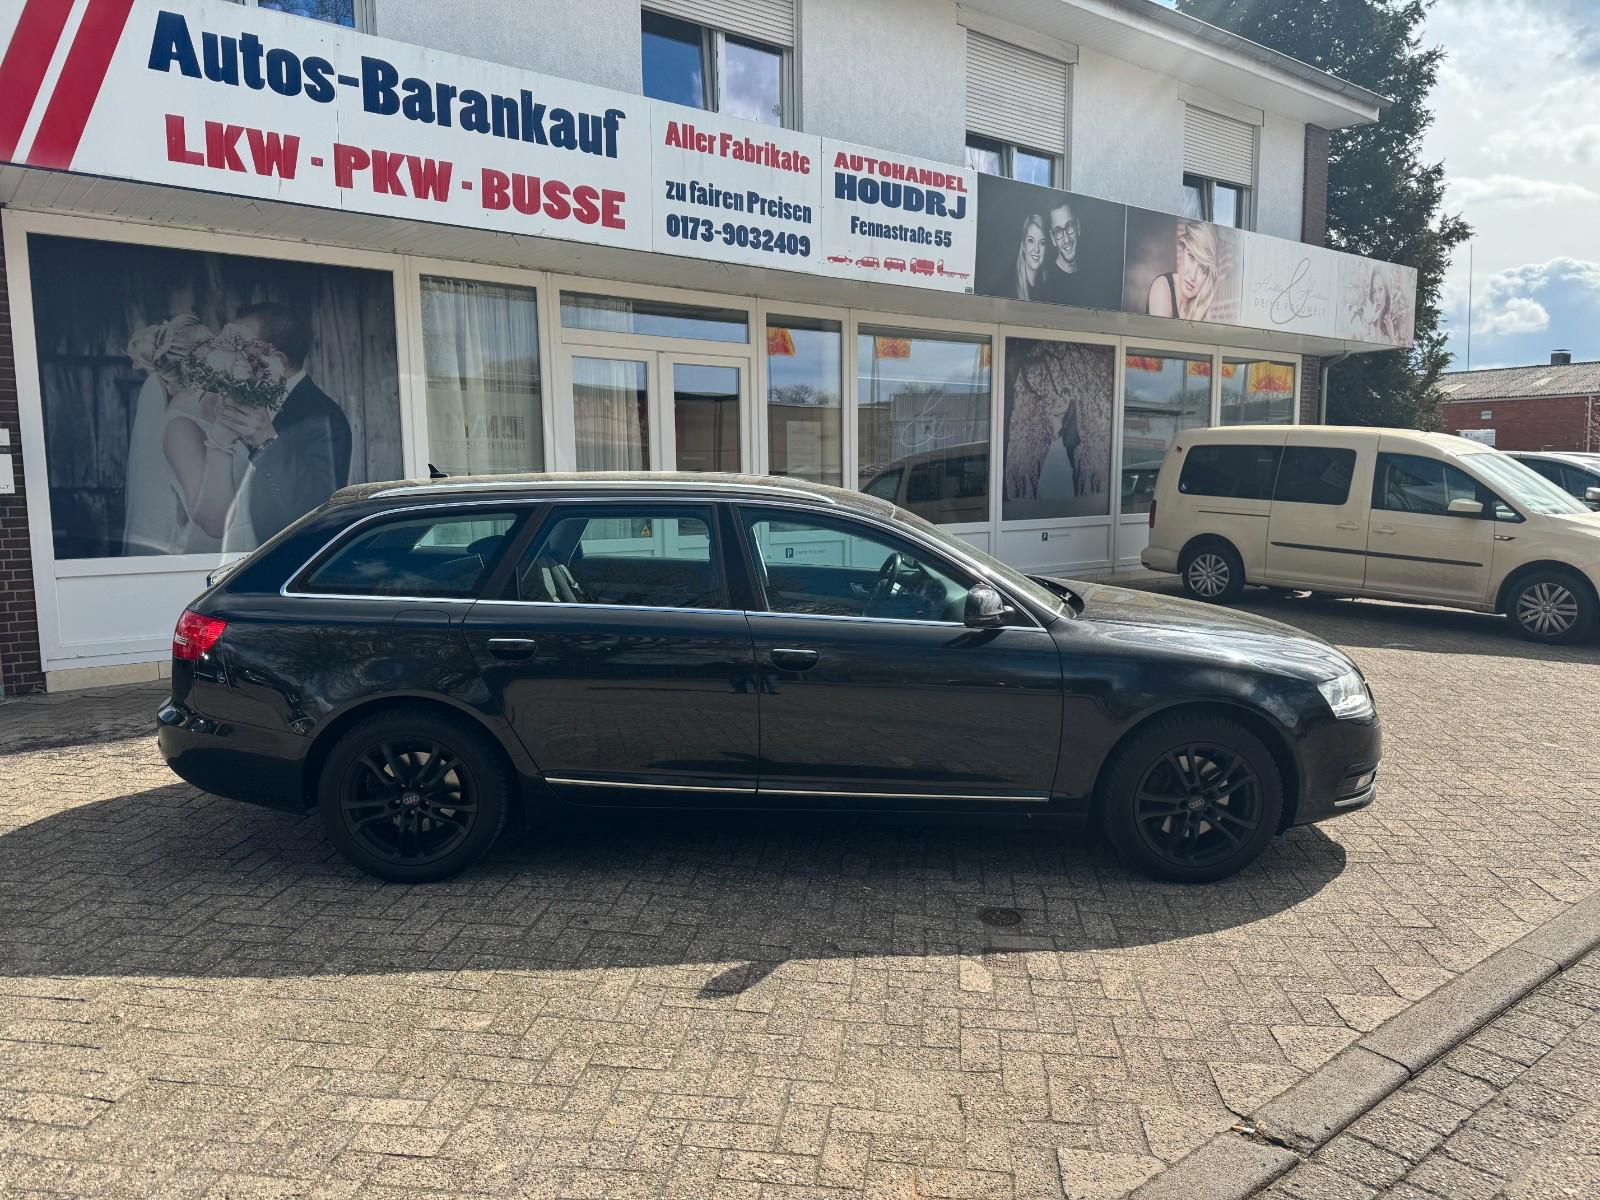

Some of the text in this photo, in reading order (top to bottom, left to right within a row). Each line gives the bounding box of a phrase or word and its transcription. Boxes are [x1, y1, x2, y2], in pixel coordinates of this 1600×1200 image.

[148, 10, 626, 158] Autos-Barankauf
[665, 121, 811, 175] Aller Fabrikate
[165, 114, 300, 180] LKW
[333, 143, 453, 203] PKW
[481, 168, 626, 230] BUSSE
[834, 152, 968, 193] AUTOHANDEL
[665, 180, 812, 224] zu fairen Preisen
[834, 172, 967, 220] HOUDRJ
[666, 214, 811, 257] 0173-9032409
[851, 216, 953, 248] Fennastraße 55
